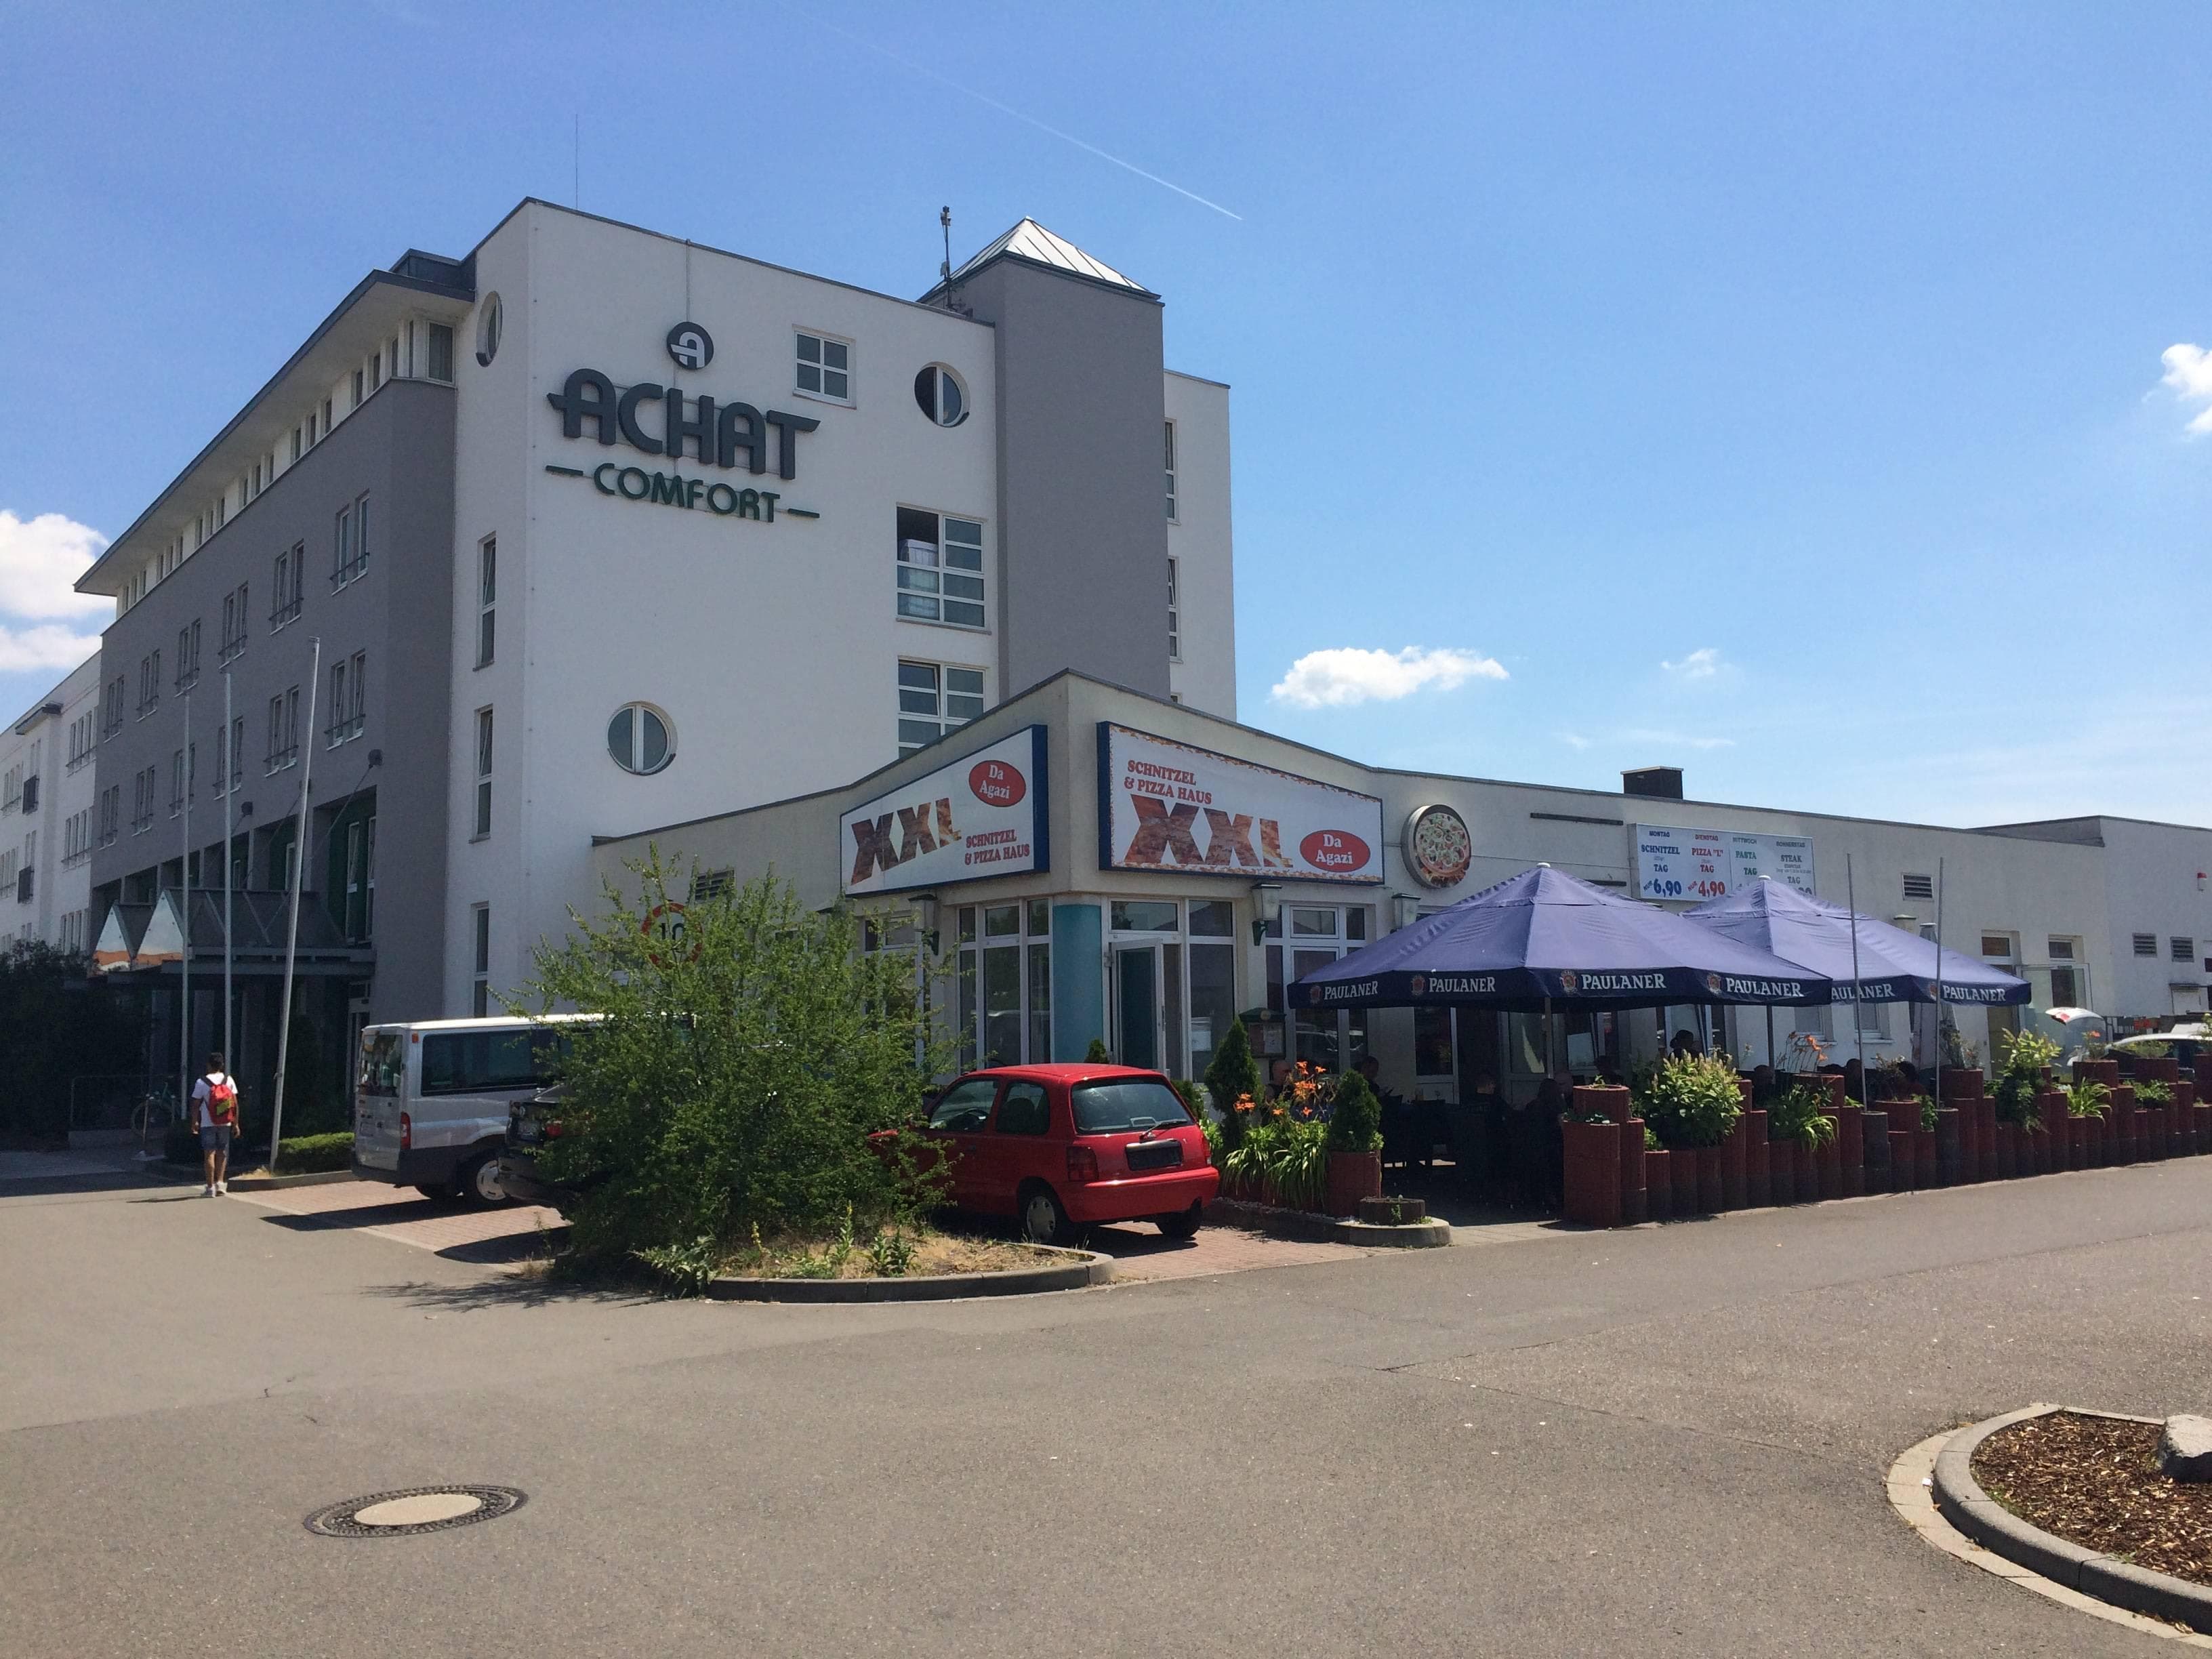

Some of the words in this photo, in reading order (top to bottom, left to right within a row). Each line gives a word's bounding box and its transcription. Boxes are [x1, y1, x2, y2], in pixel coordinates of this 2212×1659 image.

[547, 368, 821, 480] ACHAT
[594, 463, 780, 523] COMFORT
[989, 764, 1004, 779] Da
[1127, 760, 1196, 785] SCHNITZEL
[979, 780, 1010, 799] Agazi
[1124, 777, 1134, 789] &
[1137, 779, 1174, 798] PIZZA
[1178, 787, 1212, 804] HAUS
[966, 830, 1017, 848] SCHNITZEL
[1124, 794, 1293, 868] XXL
[851, 798, 962, 886] XXL
[1323, 834, 1342, 848] Da
[1641, 844, 1680, 855] SCHNITZEL
[964, 853, 972, 865] &
[975, 847, 1001, 864] PIZZA
[1004, 844, 1030, 859] HAUS
[1315, 848, 1353, 865] Agazi
[1692, 847, 1712, 856] PIZZA
[1735, 851, 1757, 859] PASTA
[1654, 864, 1668, 872] TAG
[1700, 865, 1715, 873] TAG
[1654, 878, 1682, 897] 6,90
[1698, 880, 1725, 897] 4,90
[1787, 876, 1801, 884] TAG
[1429, 977, 1496, 994] PAULANER
[1581, 974, 1666, 989] PAULANER
[1726, 977, 1805, 998] PAULANER
[1324, 981, 1378, 1000] PAULANER
[1830, 983, 1896, 1000] AULANER
[1942, 985, 2006, 1002] PAULANER
